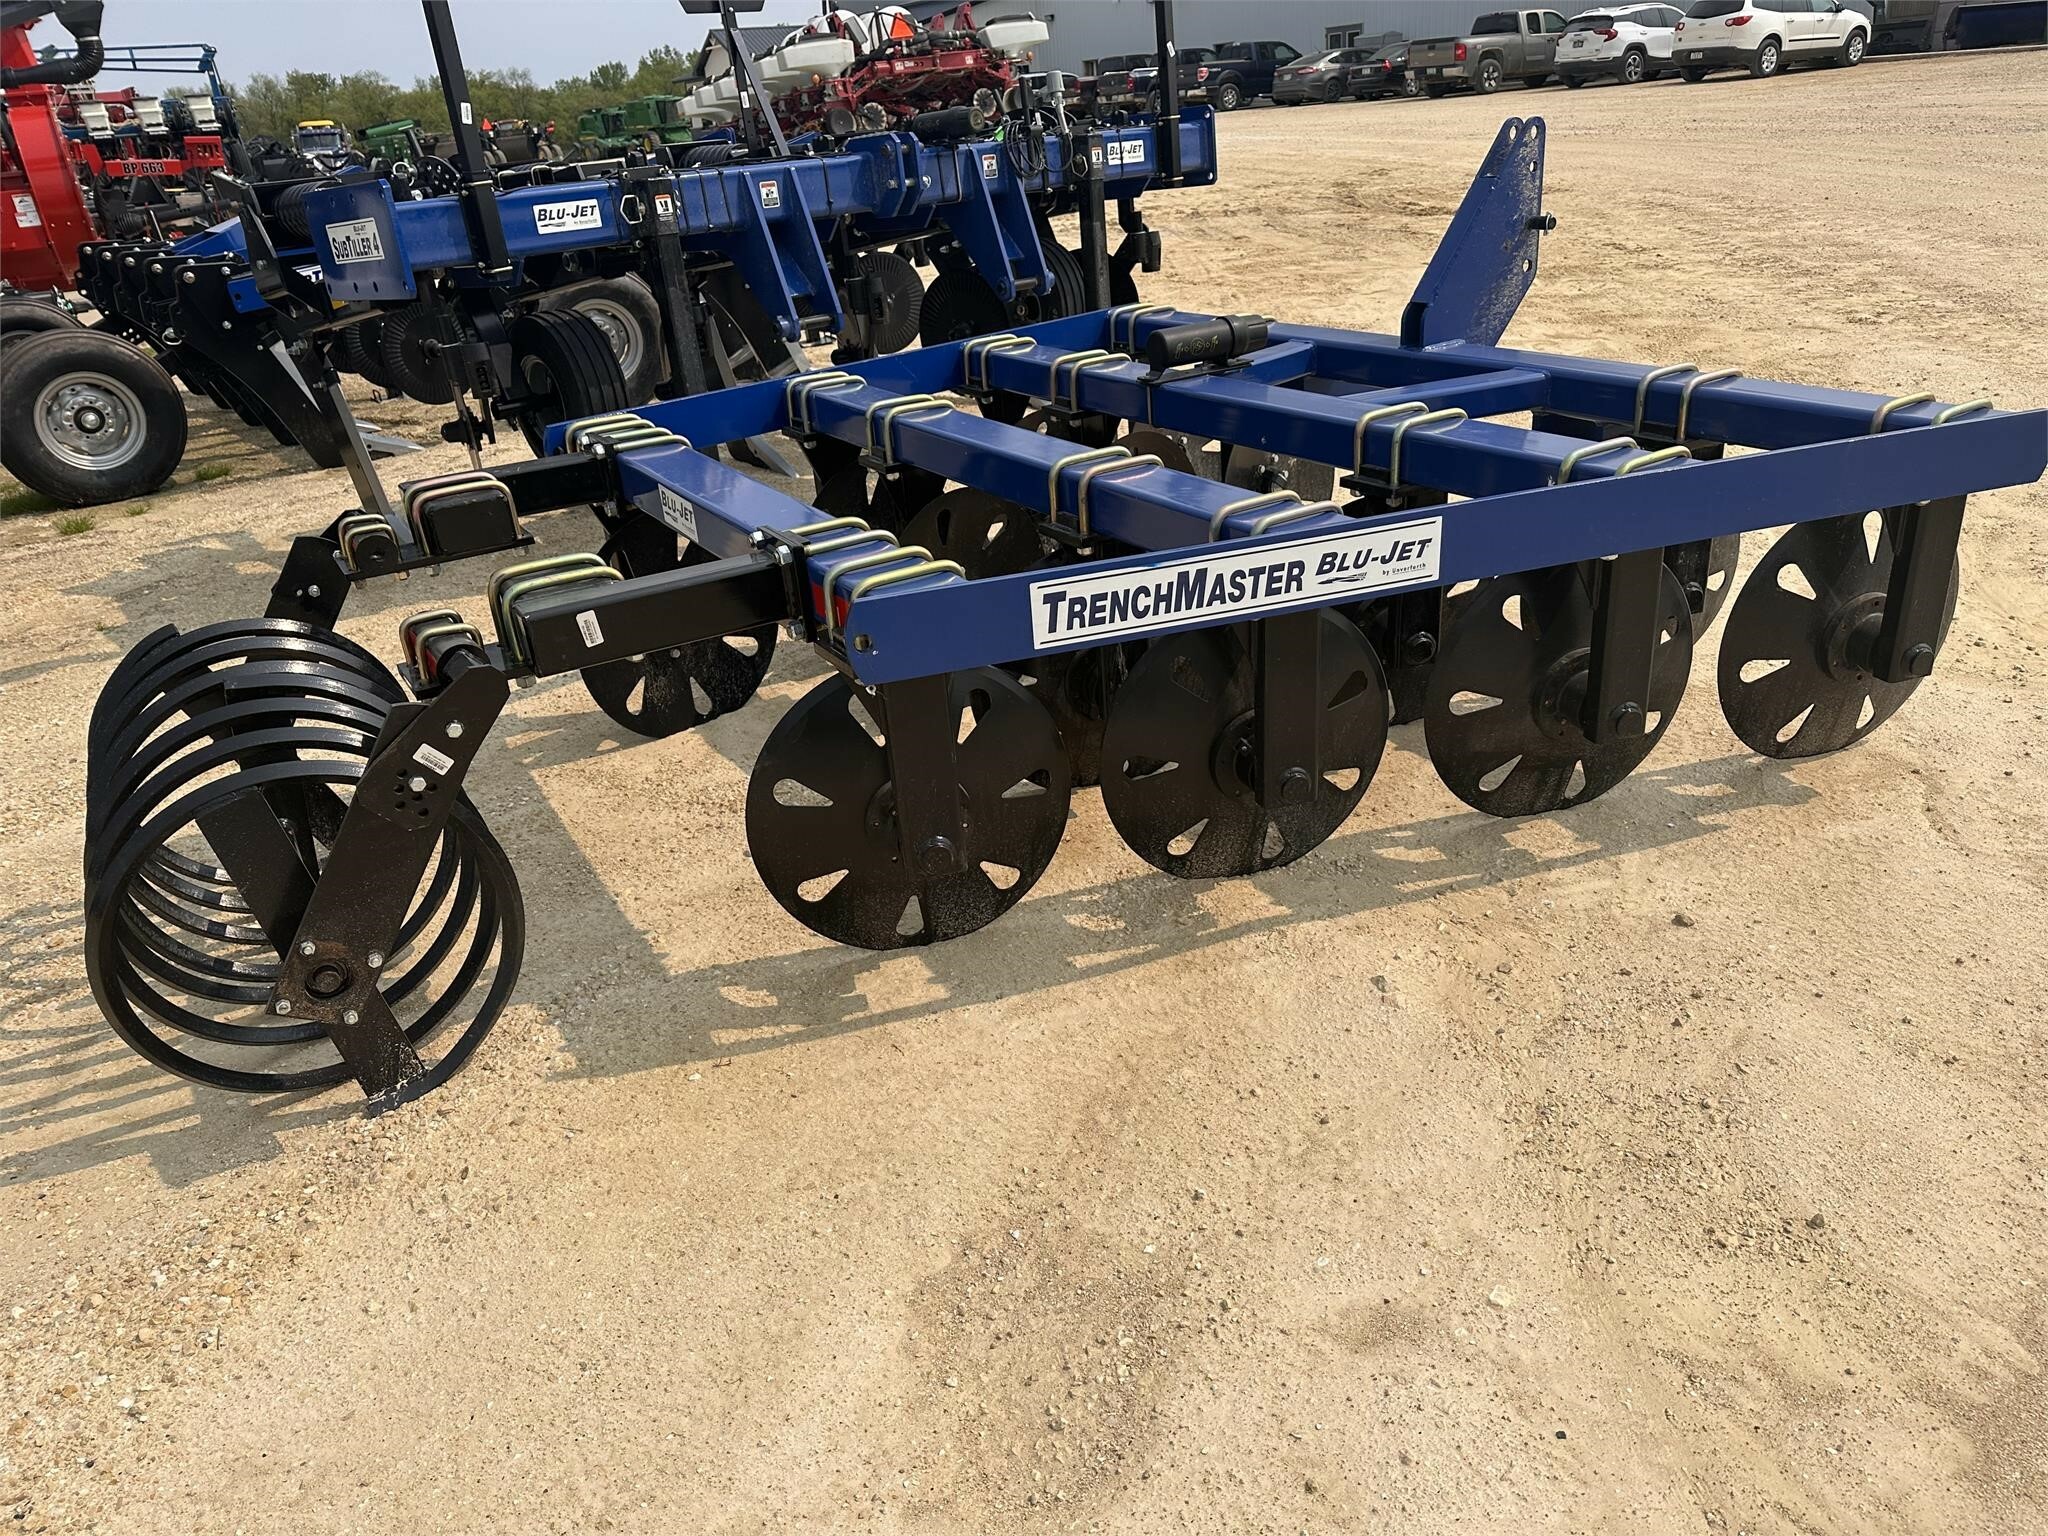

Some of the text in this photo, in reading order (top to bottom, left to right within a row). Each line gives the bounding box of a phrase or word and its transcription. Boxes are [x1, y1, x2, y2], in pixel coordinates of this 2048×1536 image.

[122, 162, 165, 174] BP 663
[537, 205, 597, 222] BLU-JET
[332, 232, 380, 259] SUBTILLER 4
[661, 490, 693, 524] BLU-JET
[1042, 538, 1433, 634] TRENCHMASTER BLU-JET
